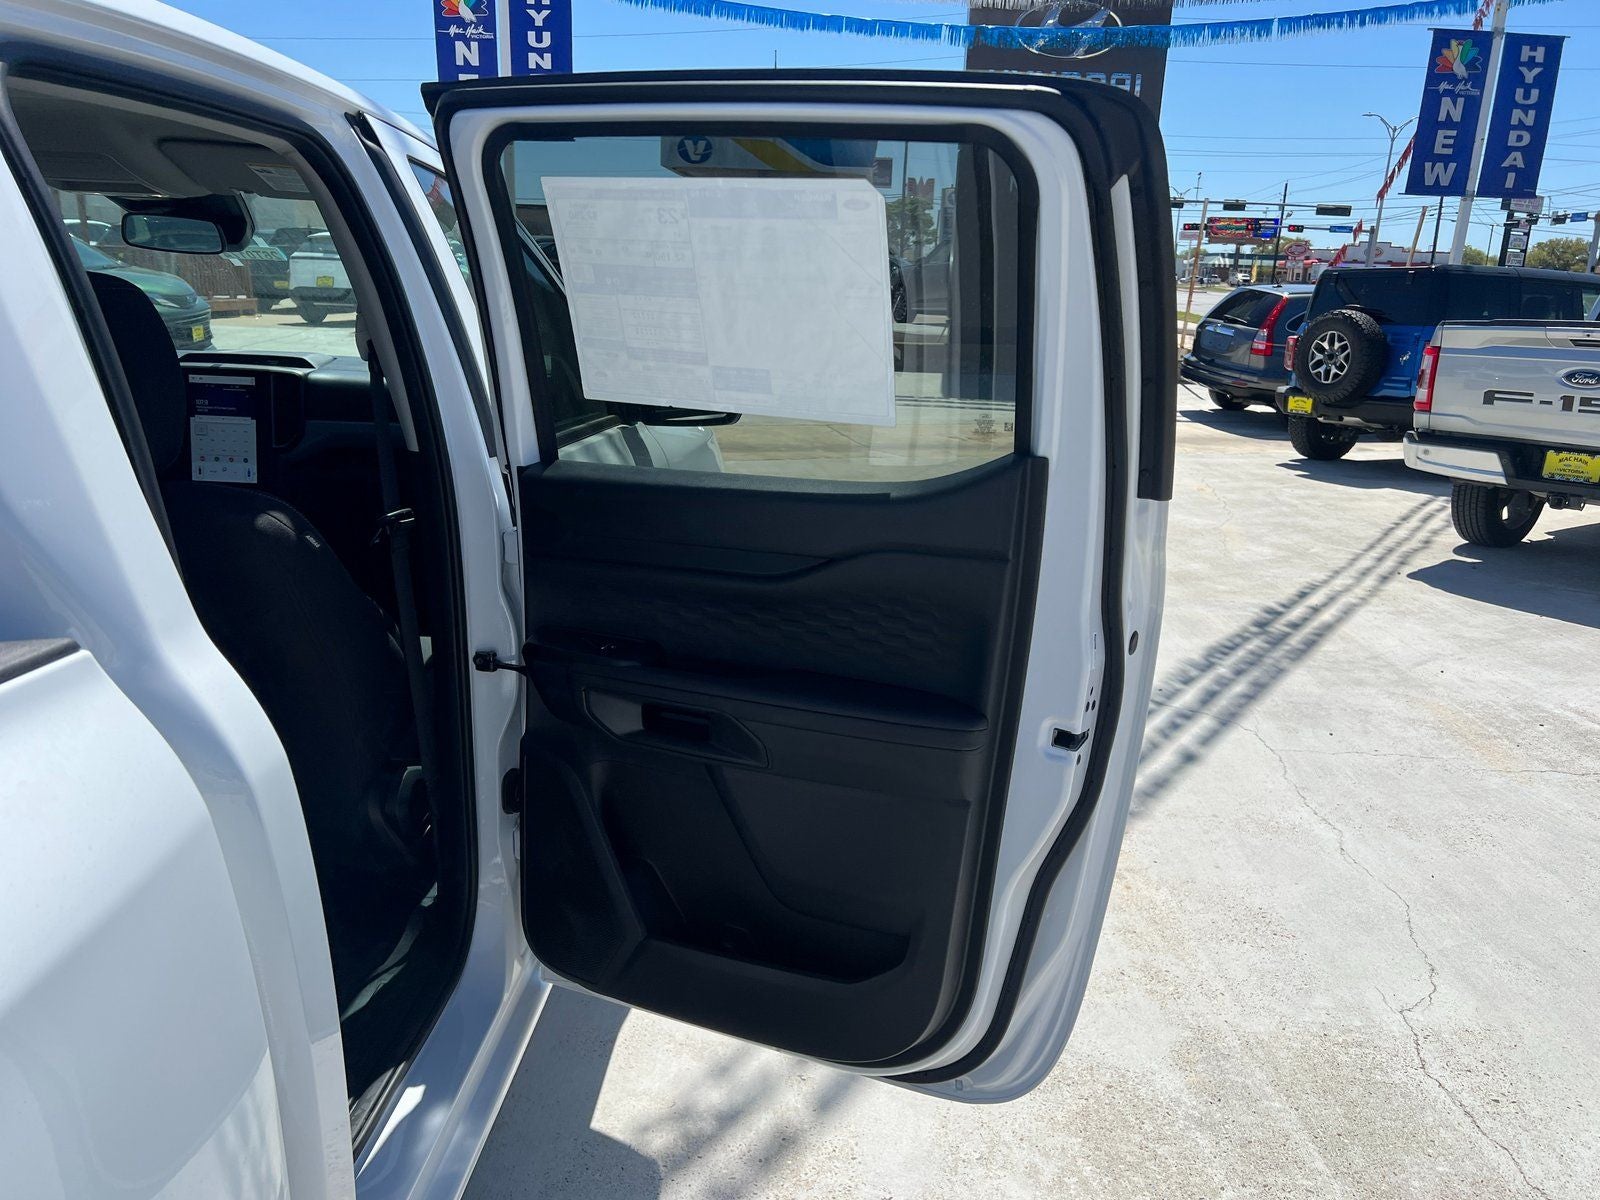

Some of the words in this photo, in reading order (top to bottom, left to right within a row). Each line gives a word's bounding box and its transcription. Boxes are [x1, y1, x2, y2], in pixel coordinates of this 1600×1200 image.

[437, 24, 465, 37] Mac
[465, 24, 493, 38] Haik
[1423, 96, 1464, 187] NEW
[1501, 45, 1545, 189] HYUNDAI
[1571, 372, 1598, 384] Ford
